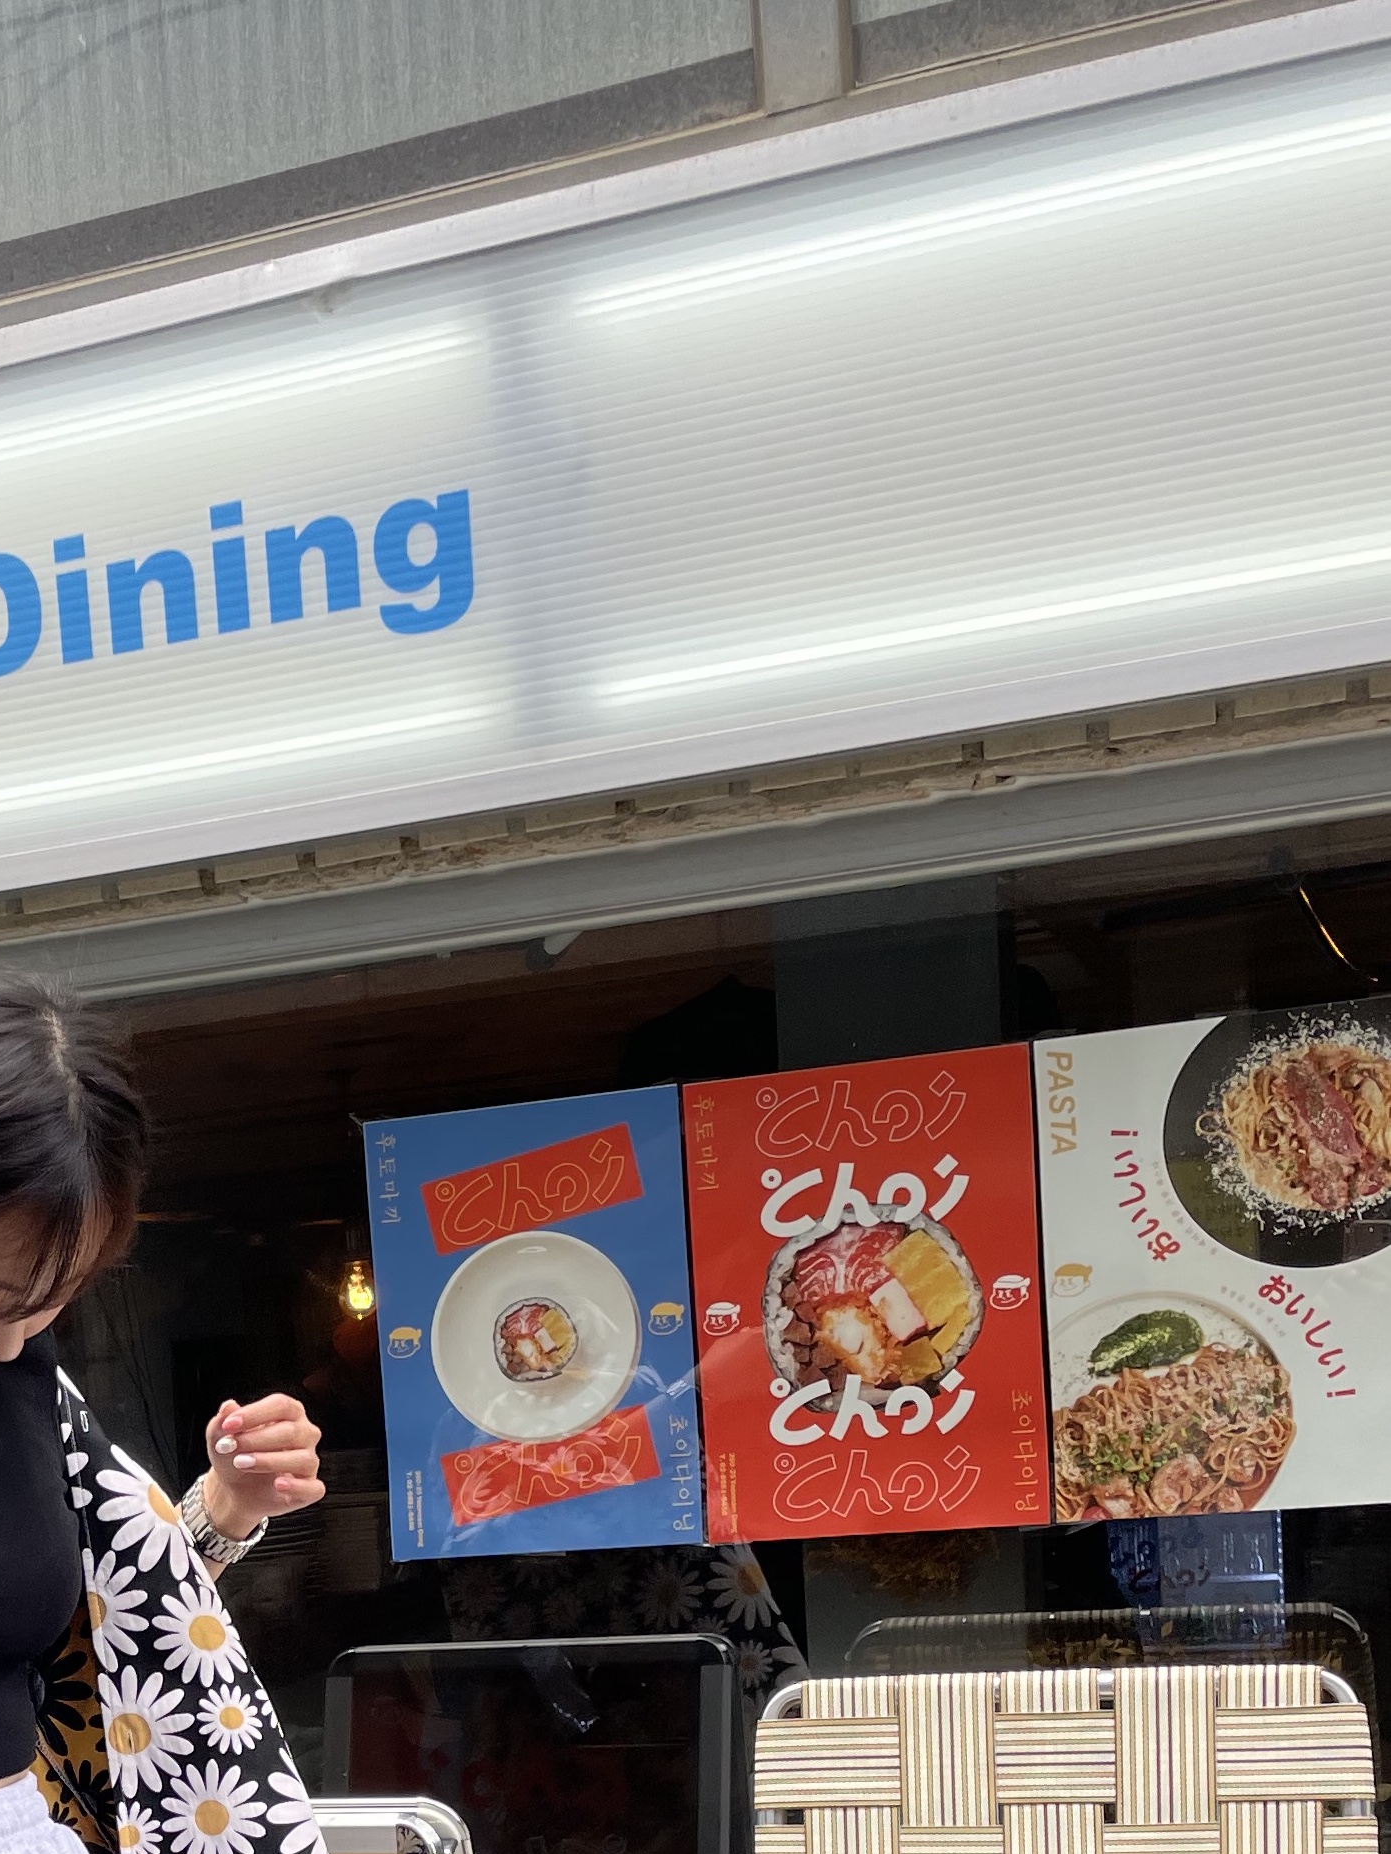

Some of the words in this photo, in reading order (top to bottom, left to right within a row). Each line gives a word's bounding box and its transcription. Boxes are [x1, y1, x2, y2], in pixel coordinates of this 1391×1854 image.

[1045, 1050, 1078, 1156] PASTA
[668, 1413, 696, 1533] 초이다이닝
[1010, 1388, 1041, 1513] 초이다이닝
